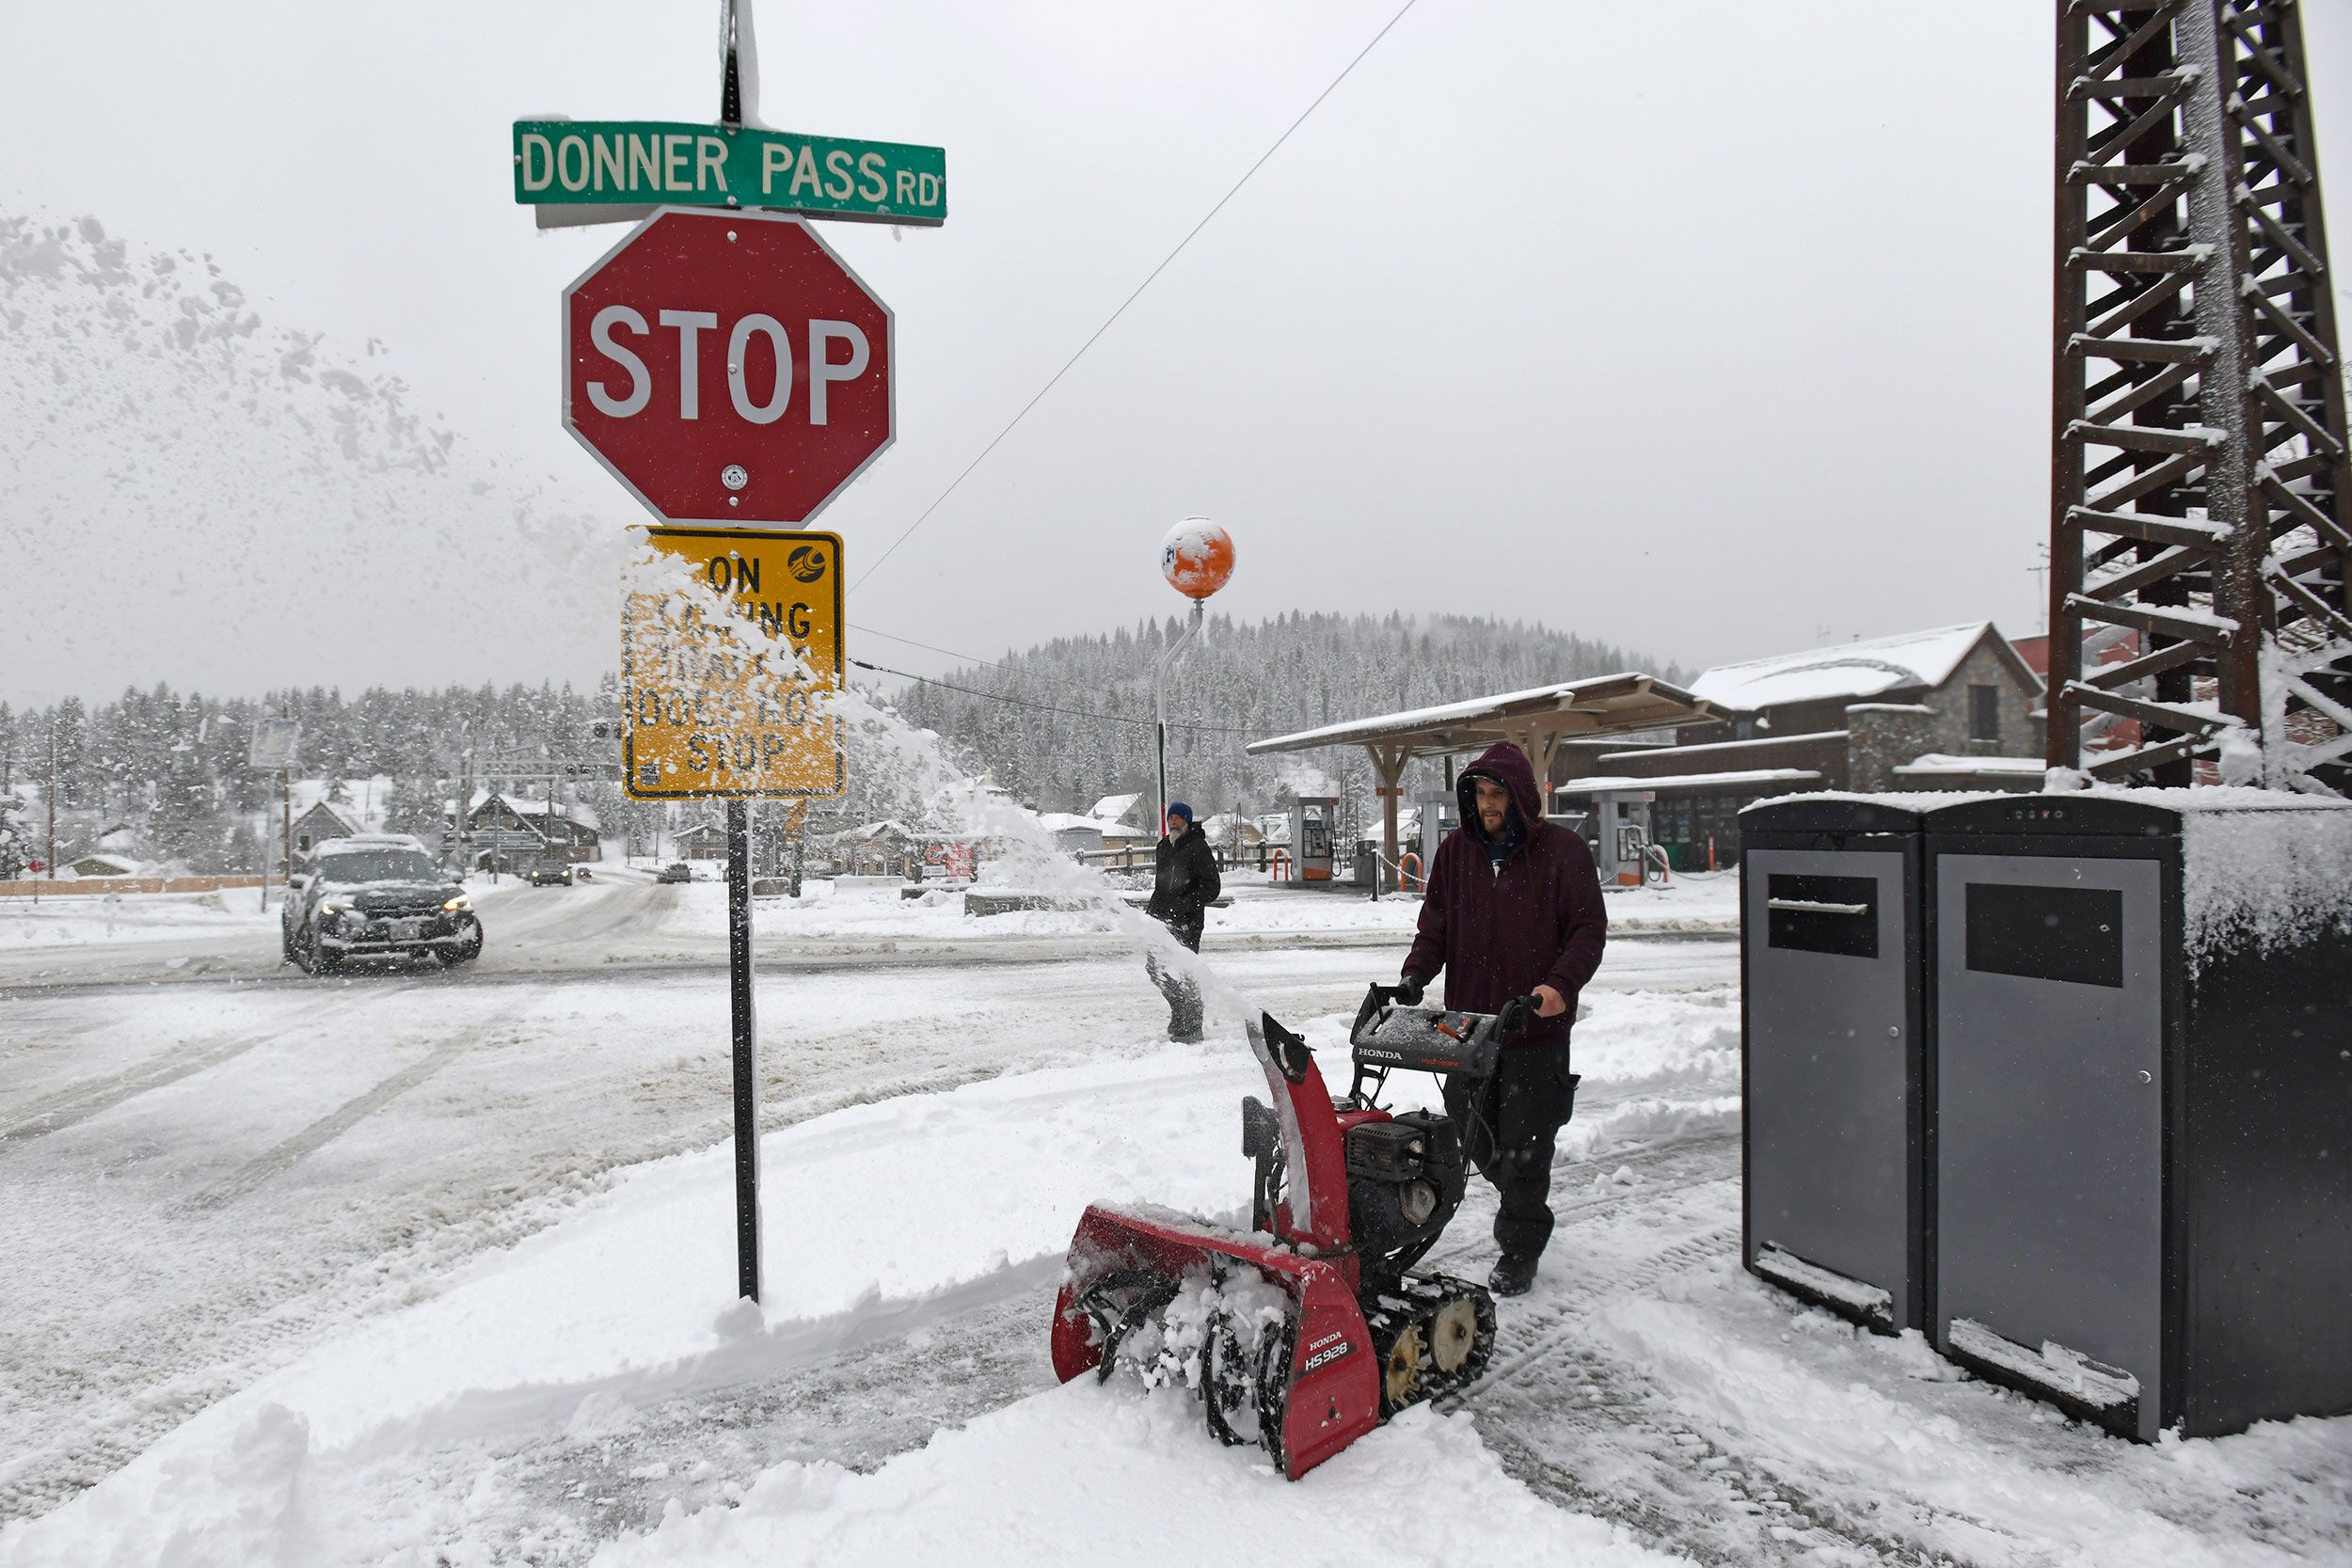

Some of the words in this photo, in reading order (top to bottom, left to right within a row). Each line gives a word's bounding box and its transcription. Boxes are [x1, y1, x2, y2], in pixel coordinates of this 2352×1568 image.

[521, 133, 728, 192] DONNER
[762, 142, 887, 200] PASS
[897, 169, 939, 206] RD
[586, 305, 870, 426] STOP
[688, 733, 786, 771] STOP
[1358, 1048, 1403, 1060] HONDA
[1305, 1341, 1348, 1371] HS928
[1310, 1331, 1343, 1351] HONDA
